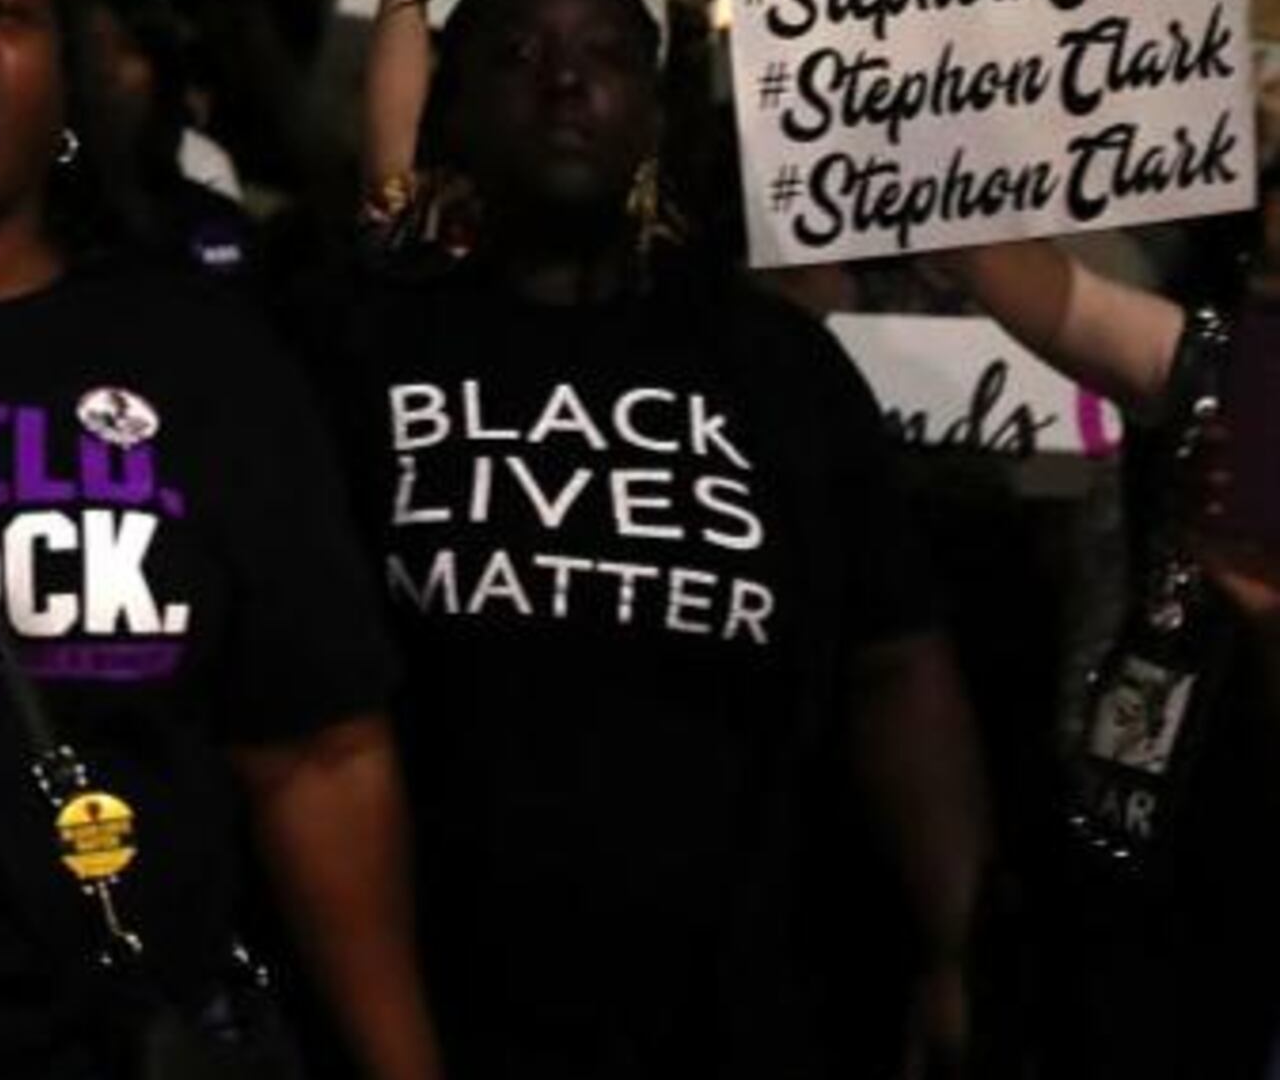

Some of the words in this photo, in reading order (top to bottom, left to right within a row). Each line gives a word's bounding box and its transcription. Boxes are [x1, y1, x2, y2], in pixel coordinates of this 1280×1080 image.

[757, 40, 1052, 145] #Stephon
[1057, 4, 1238, 117] Clark
[769, 142, 1058, 248] #Stephon
[1066, 110, 1241, 223] Clark
[392, 454, 768, 552] LIVES
[386, 548, 777, 650] MATTER
